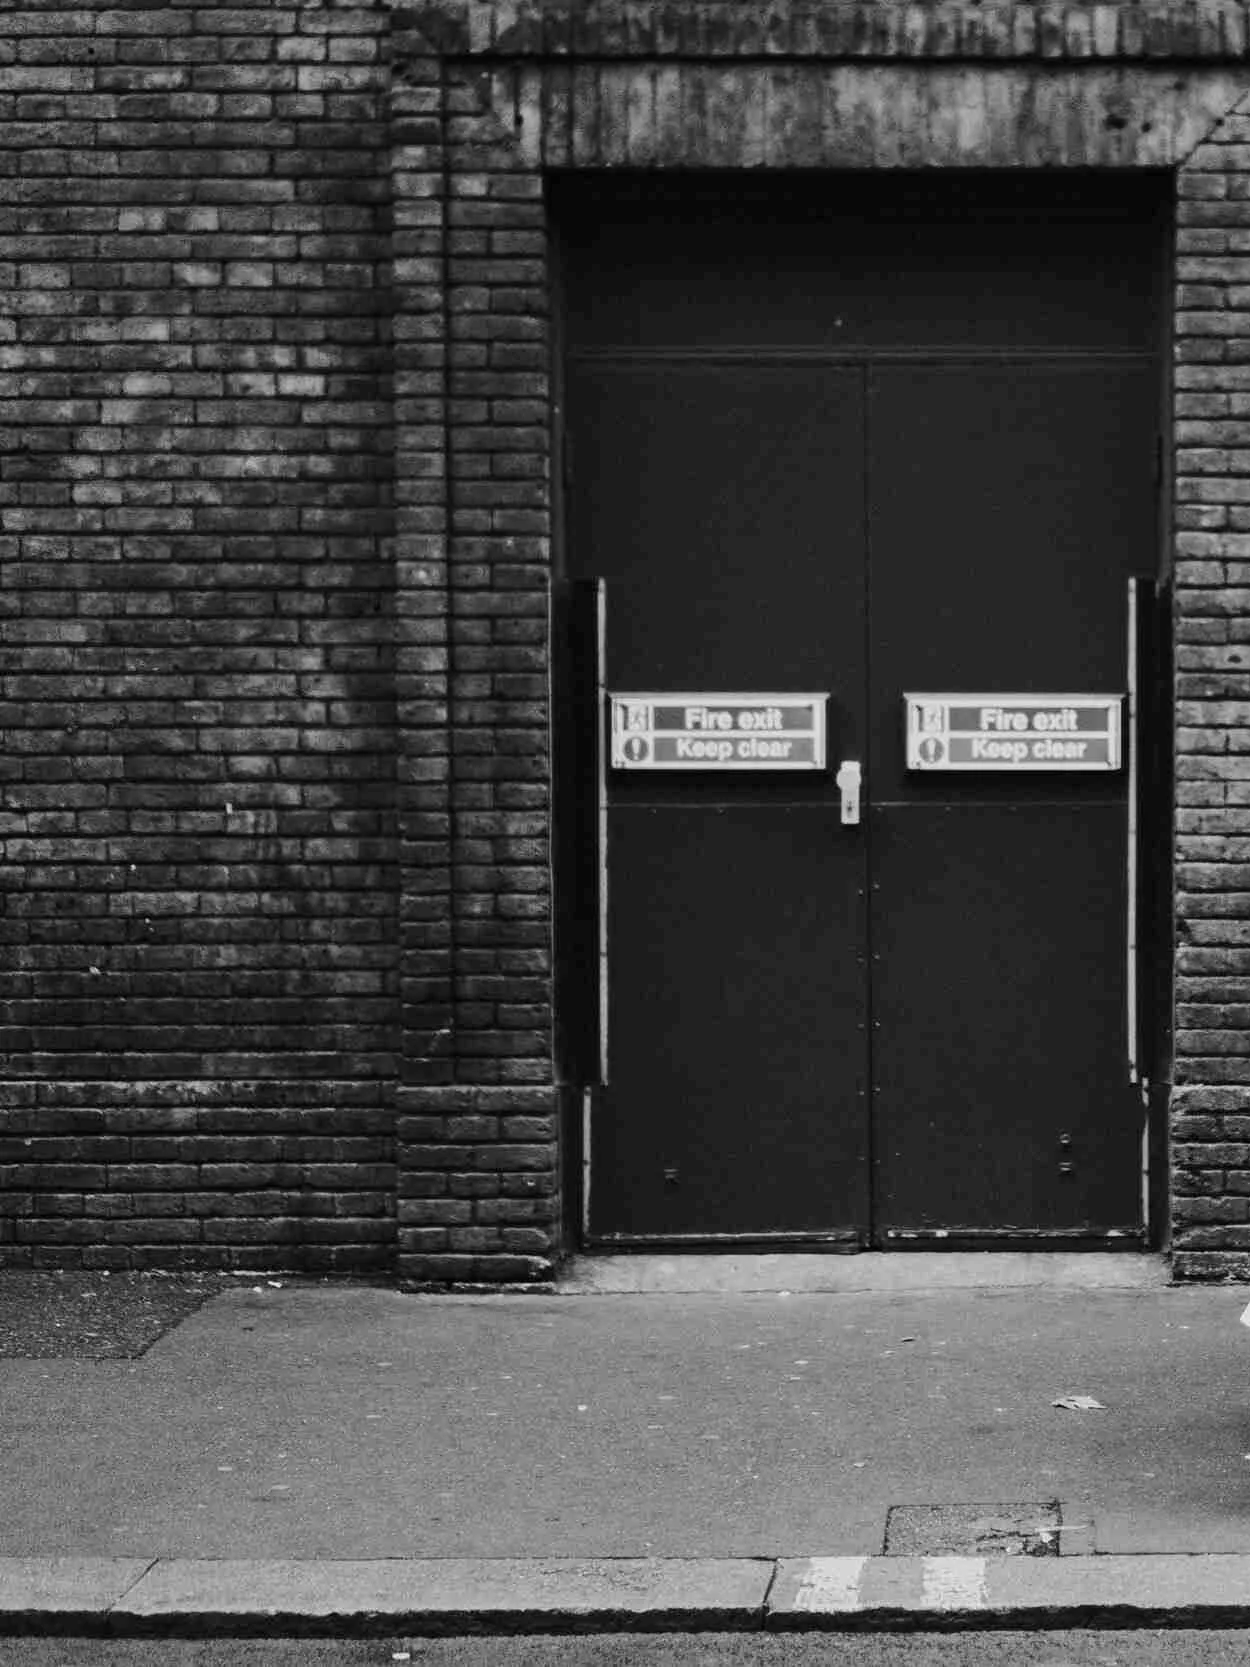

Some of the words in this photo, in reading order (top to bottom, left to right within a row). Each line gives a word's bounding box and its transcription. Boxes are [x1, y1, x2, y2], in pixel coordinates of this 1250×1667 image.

[685, 708, 732, 730] Fire
[738, 708, 783, 730] exit
[980, 708, 1028, 731] Fire
[1032, 709, 1078, 731] exit
[676, 738, 733, 761] Keep
[738, 738, 793, 758] clear
[971, 738, 1028, 762] Keep
[1032, 739, 1087, 759] clear
